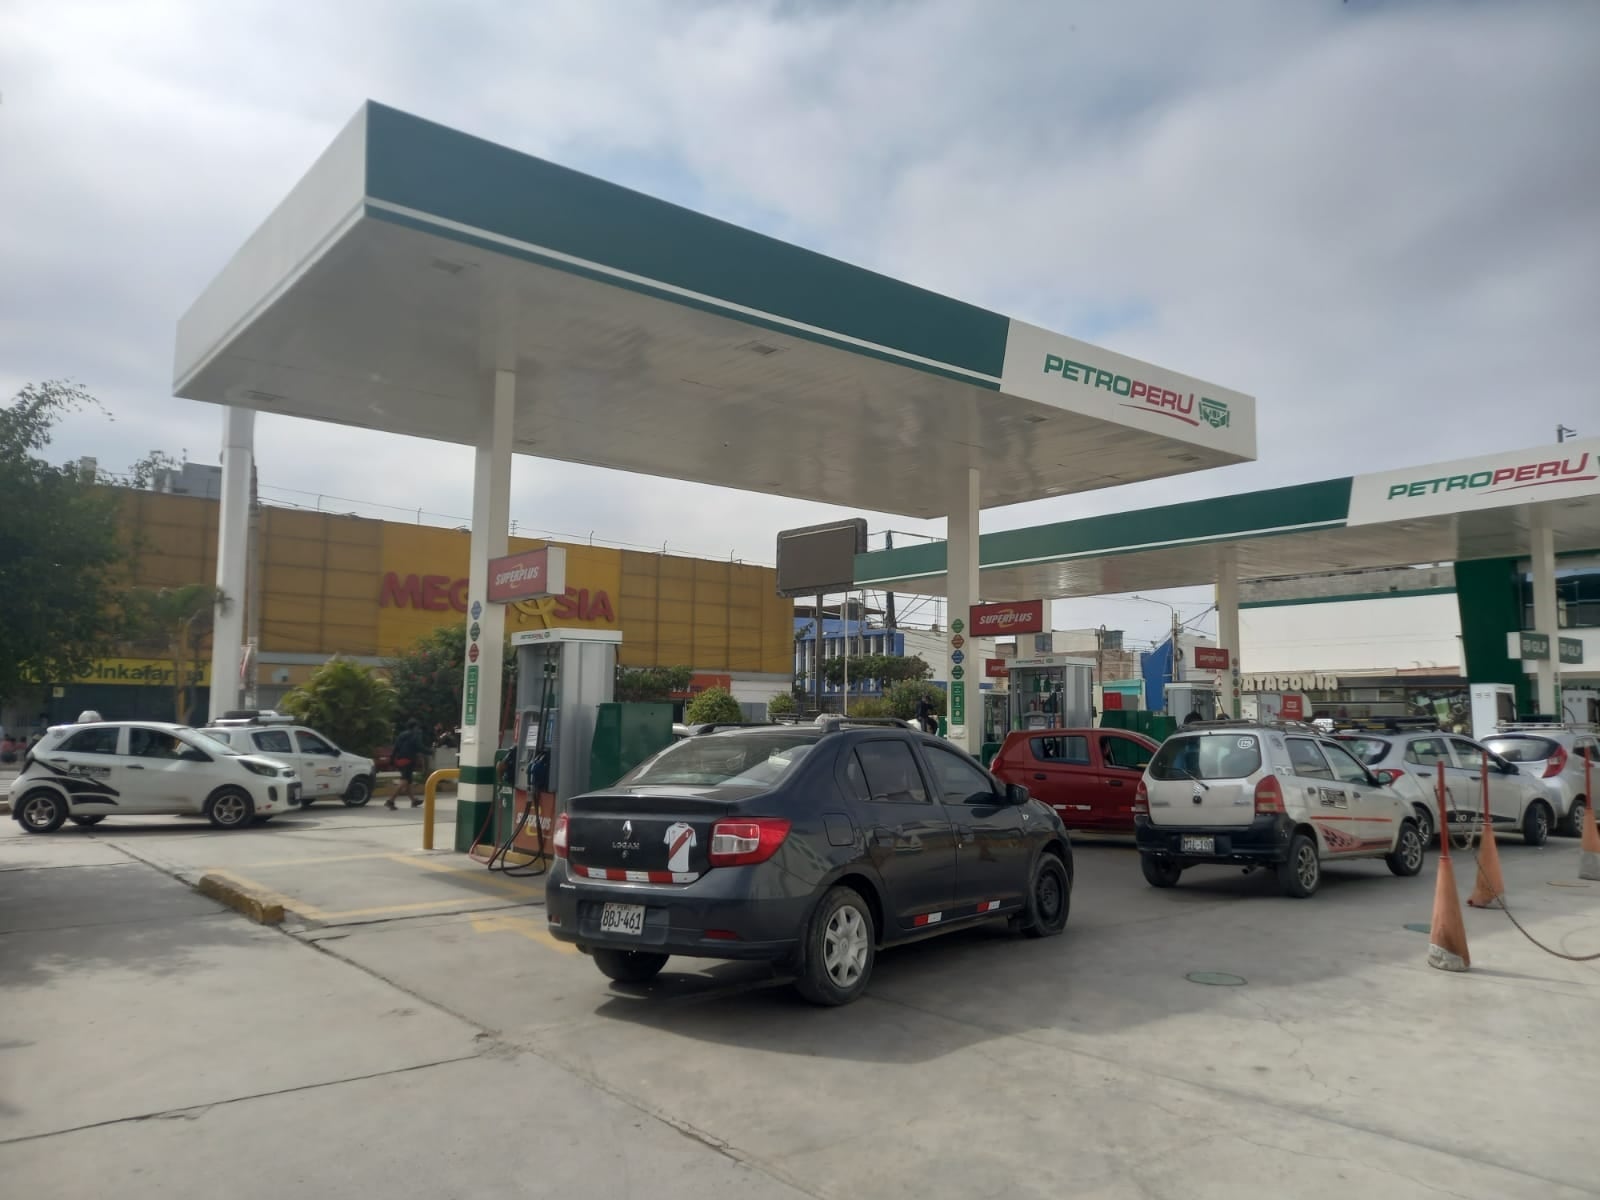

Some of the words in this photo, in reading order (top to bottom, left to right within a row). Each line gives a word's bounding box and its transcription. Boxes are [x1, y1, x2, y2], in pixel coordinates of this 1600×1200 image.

[1044, 353, 1194, 414] PETROPERU
[1387, 452, 1589, 500] PETROPERU
[495, 566, 540, 586] SUPERPLUS
[979, 612, 1033, 625] SUPERPLUS
[1240, 674, 1338, 691] ATAGONIA
